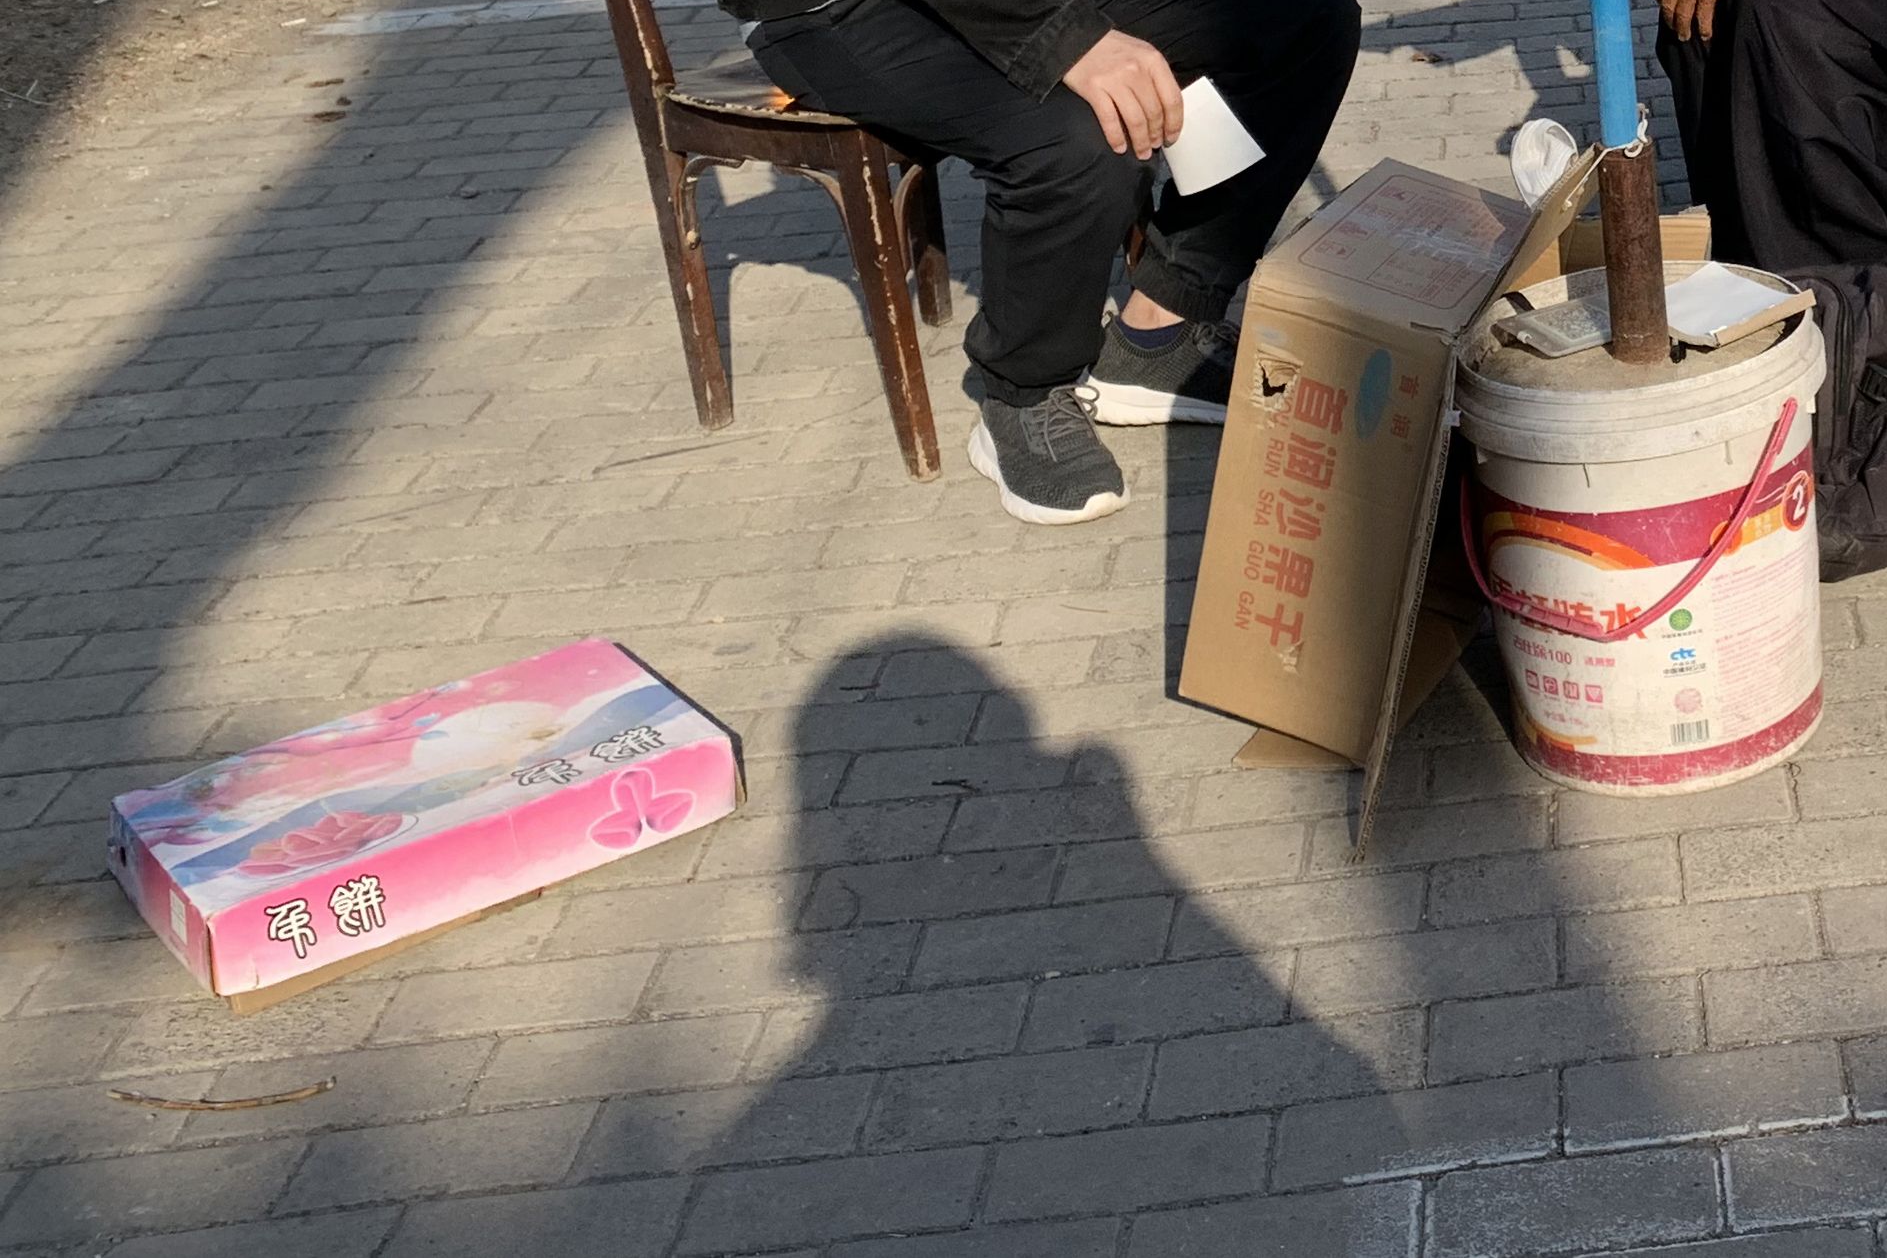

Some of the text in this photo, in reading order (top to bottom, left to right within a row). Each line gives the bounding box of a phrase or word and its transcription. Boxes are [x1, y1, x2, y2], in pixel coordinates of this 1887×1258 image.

[1263, 437, 1285, 478] RUN
[1253, 489, 1275, 527] SHA
[1254, 376, 1348, 647] 首润沙果干
[1244, 540, 1265, 581] GUO
[1234, 590, 1255, 630] GAN
